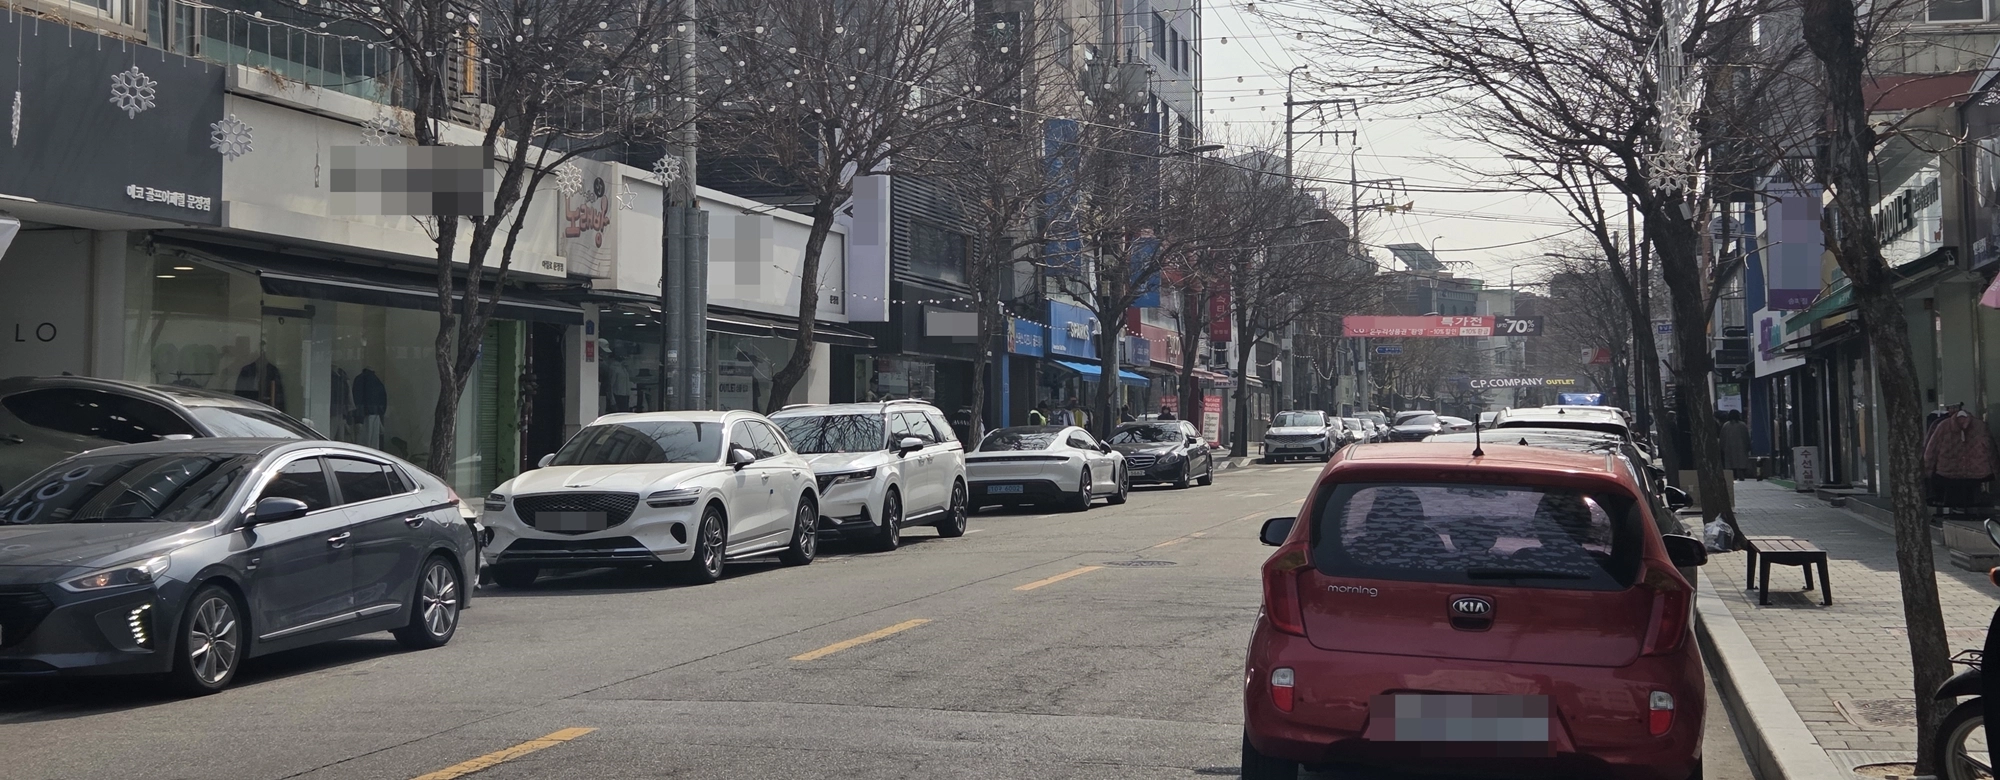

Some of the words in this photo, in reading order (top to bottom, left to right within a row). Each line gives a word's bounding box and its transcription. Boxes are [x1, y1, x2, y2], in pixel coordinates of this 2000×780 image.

[126, 184, 145, 199] 에코
[187, 194, 211, 211] 문정점
[564, 194, 610, 249] 노래방
[1441, 316, 1483, 327] 특가전
[1470, 377, 1543, 388] C.P.COMPANY
[1800, 449, 1813, 479] 수선실
[1327, 584, 1378, 598] morning
[1459, 601, 1485, 613] KIA
